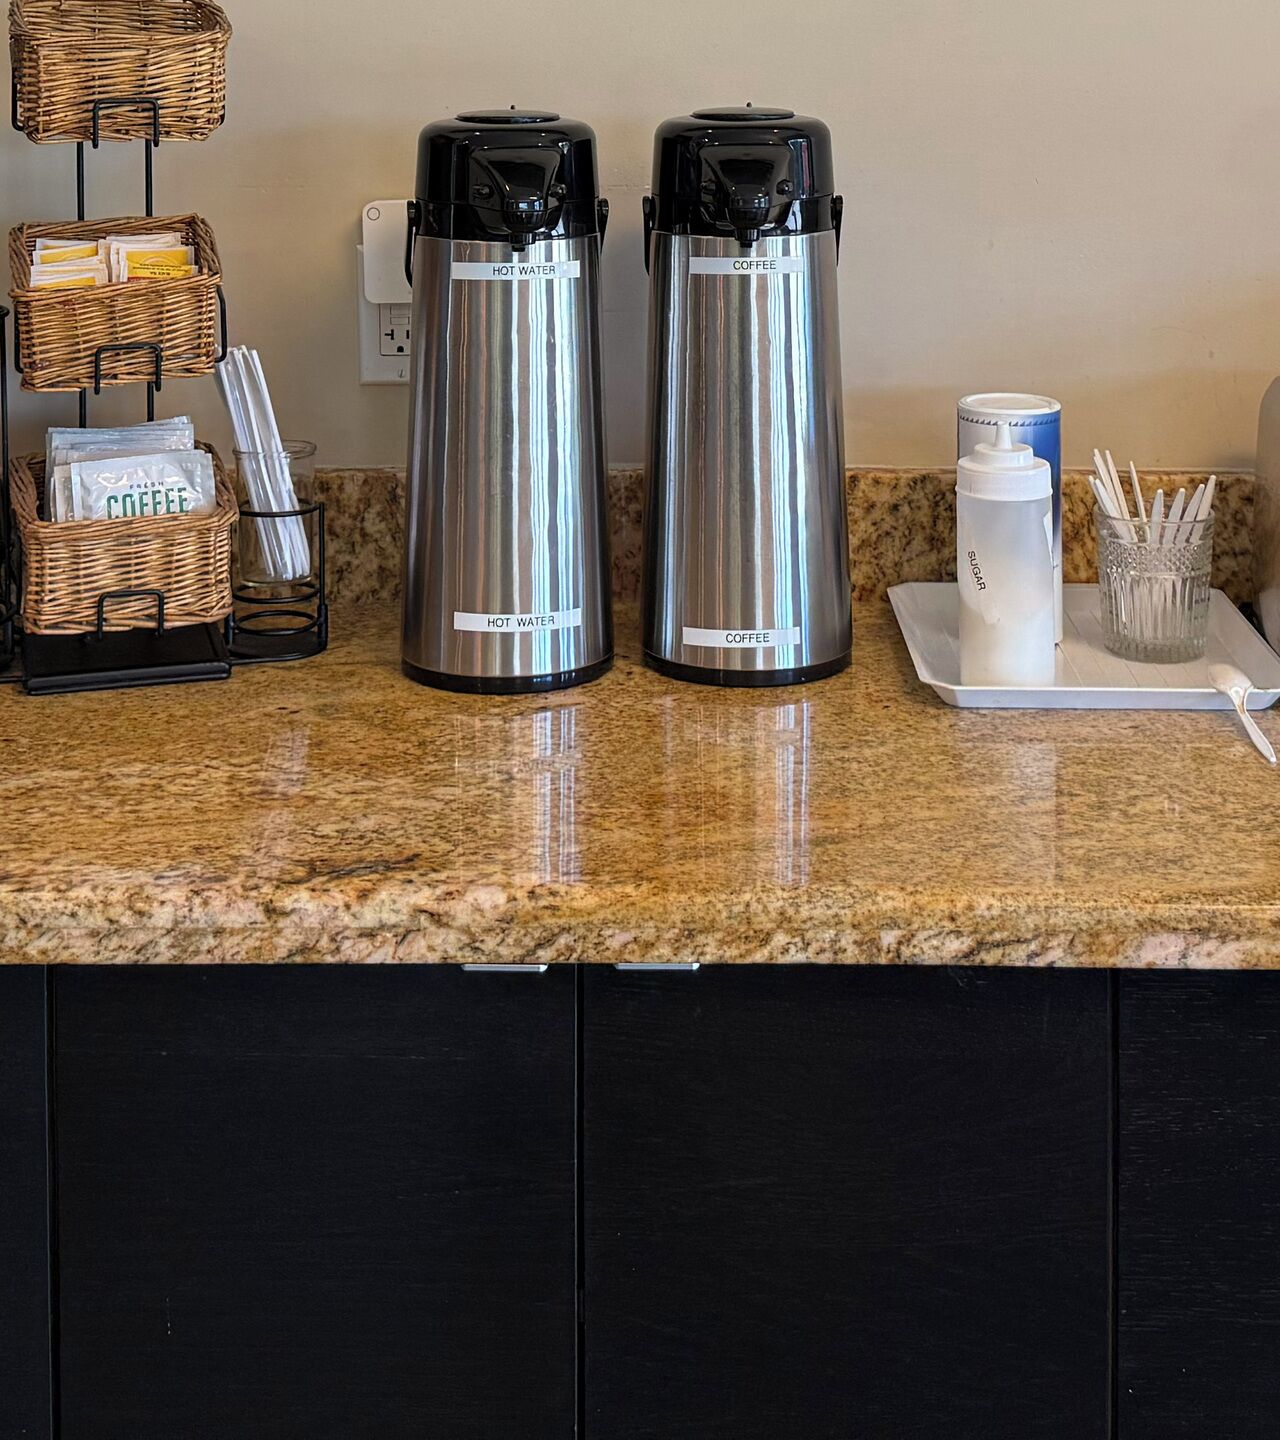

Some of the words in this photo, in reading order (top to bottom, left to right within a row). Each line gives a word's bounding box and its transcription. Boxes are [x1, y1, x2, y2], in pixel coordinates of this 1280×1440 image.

[492, 265, 515, 276] HOT
[518, 265, 556, 275] WATER
[733, 259, 777, 271] COFFEE
[106, 487, 189, 519] COFFEE
[967, 550, 986, 591] SUGAR
[487, 617, 511, 628] HOT
[516, 615, 555, 627] WATER
[725, 632, 770, 643] COFFEE
